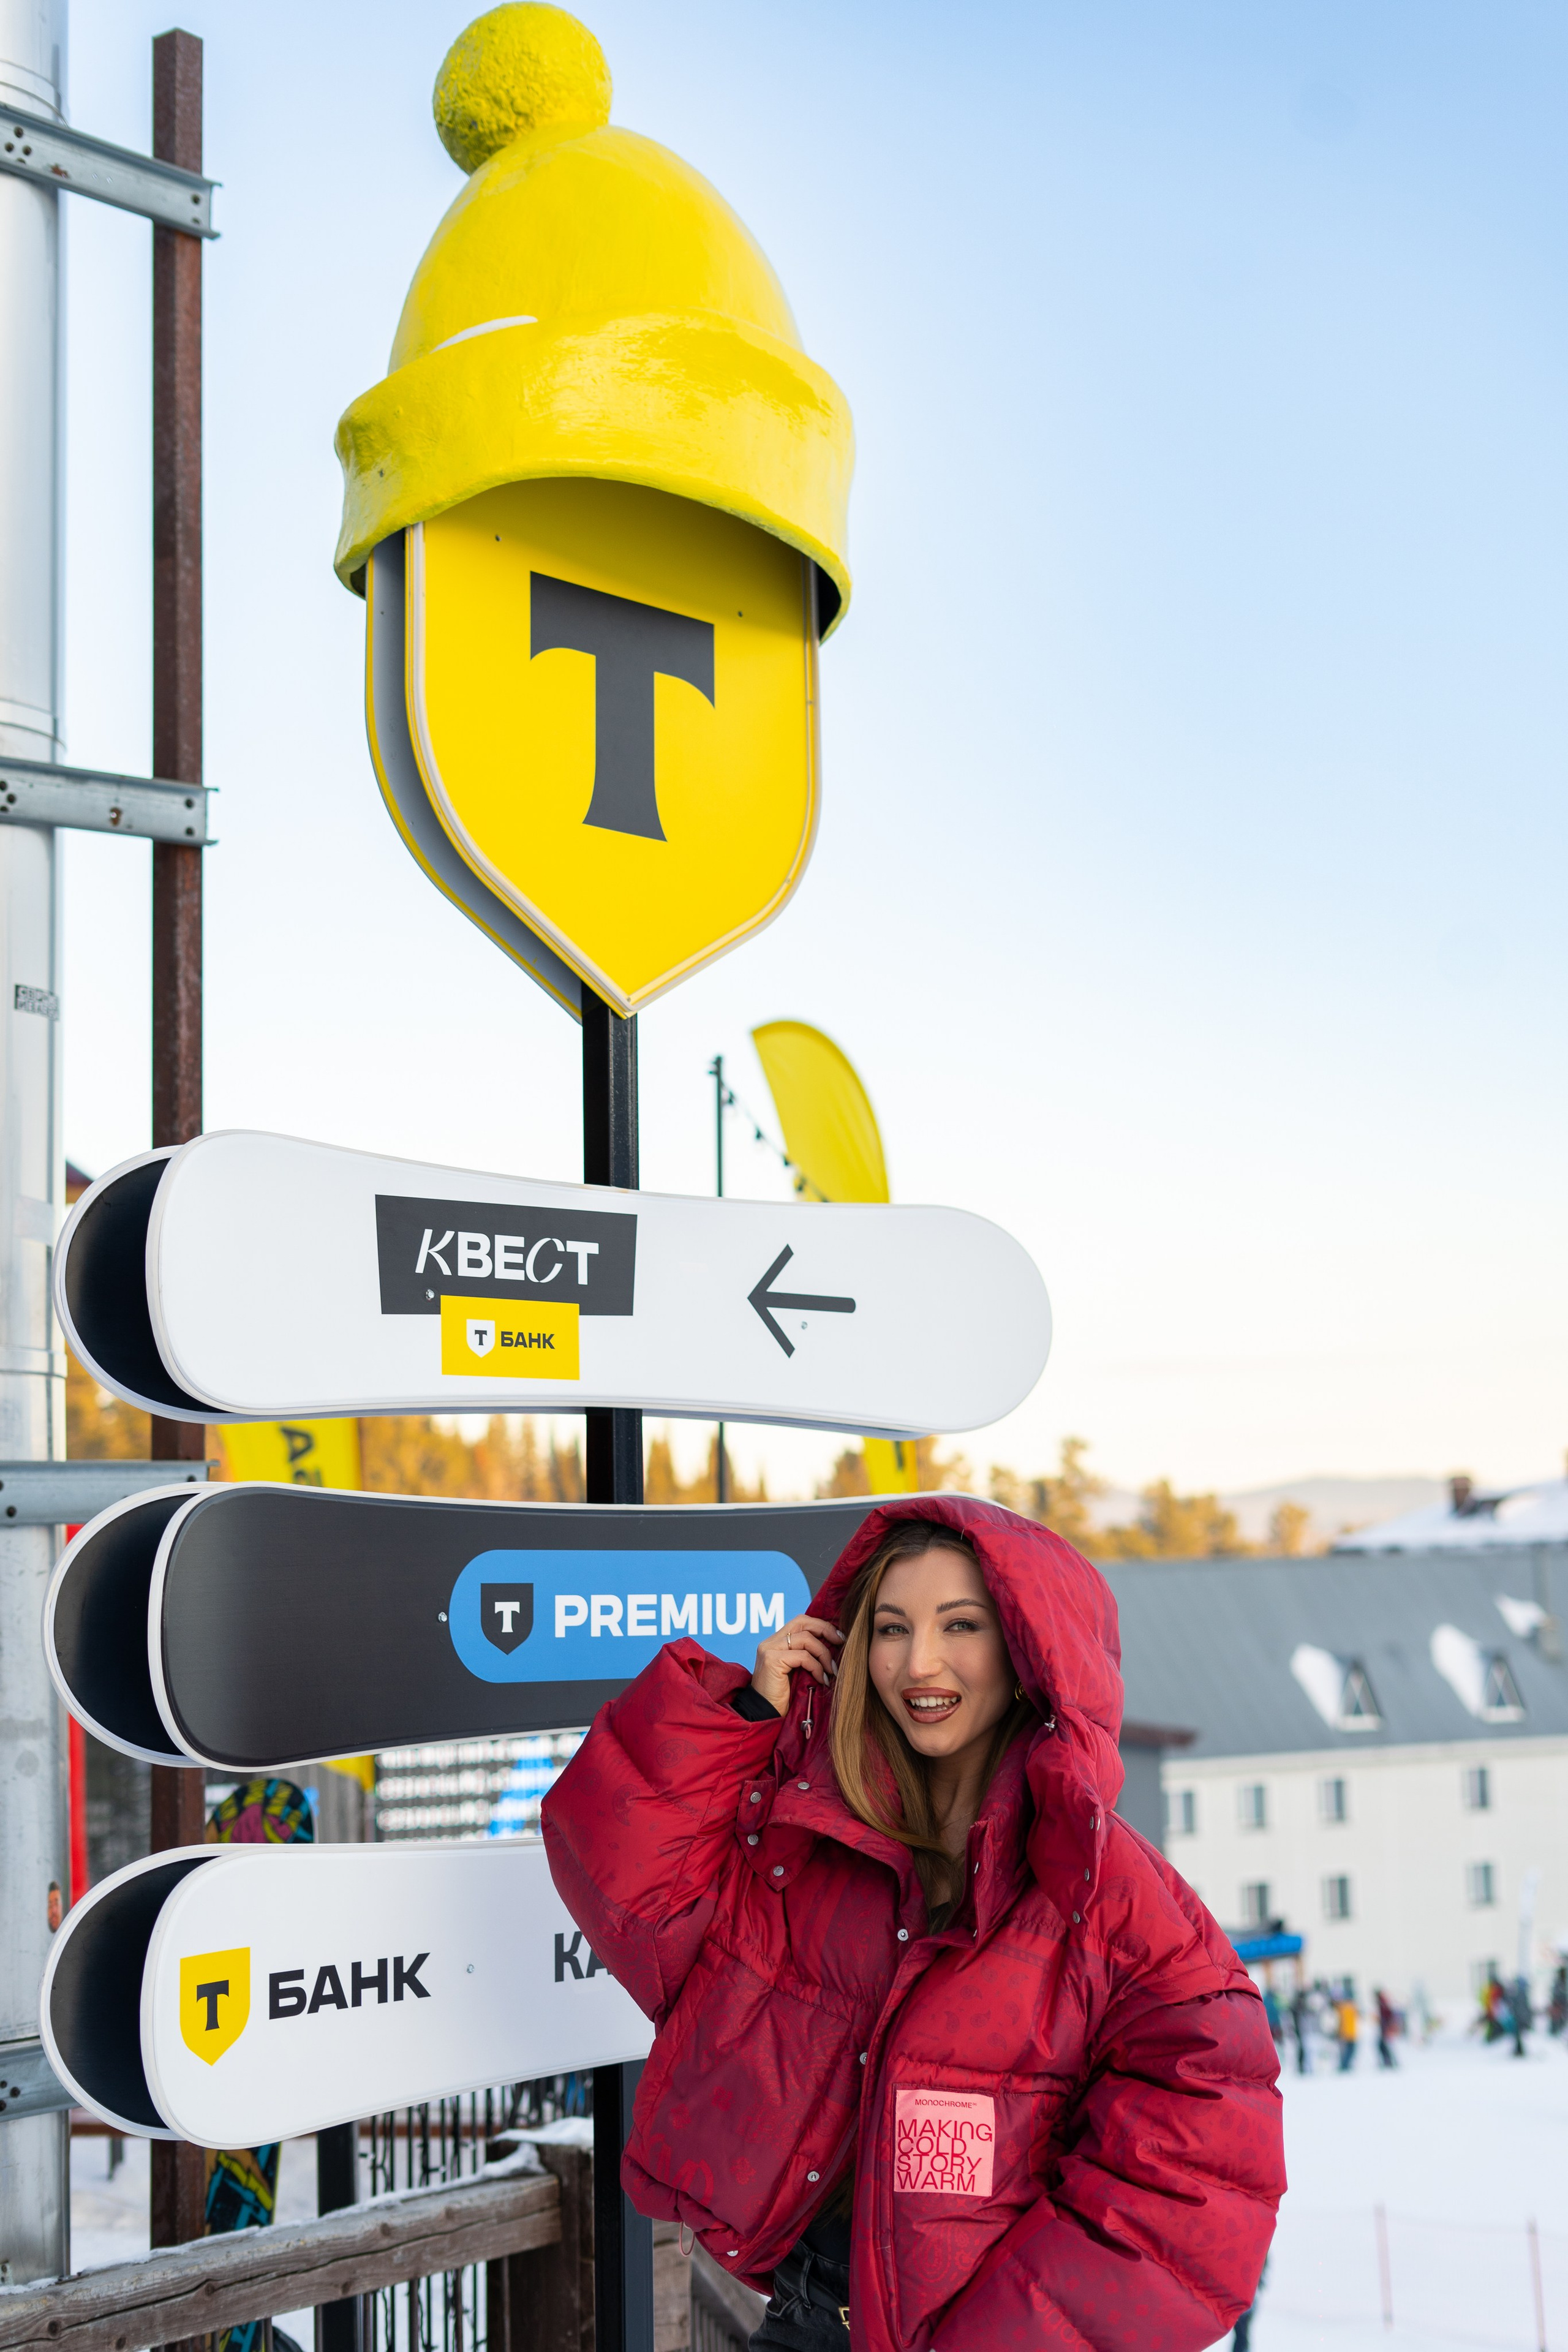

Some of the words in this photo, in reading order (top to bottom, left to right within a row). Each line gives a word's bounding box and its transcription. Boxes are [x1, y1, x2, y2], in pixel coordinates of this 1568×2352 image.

[415, 1228, 600, 1286] КВЕСТ
[500, 1331, 556, 1349] БАНК
[554, 1593, 785, 1638] PREMIUM
[268, 1952, 432, 2020] БАНК
[914, 2098, 973, 2108] MONOCHROME
[898, 2119, 993, 2142] MAKING
[897, 2136, 967, 2156] COLD
[897, 2154, 982, 2174] STORY
[897, 2171, 975, 2193] WARM
